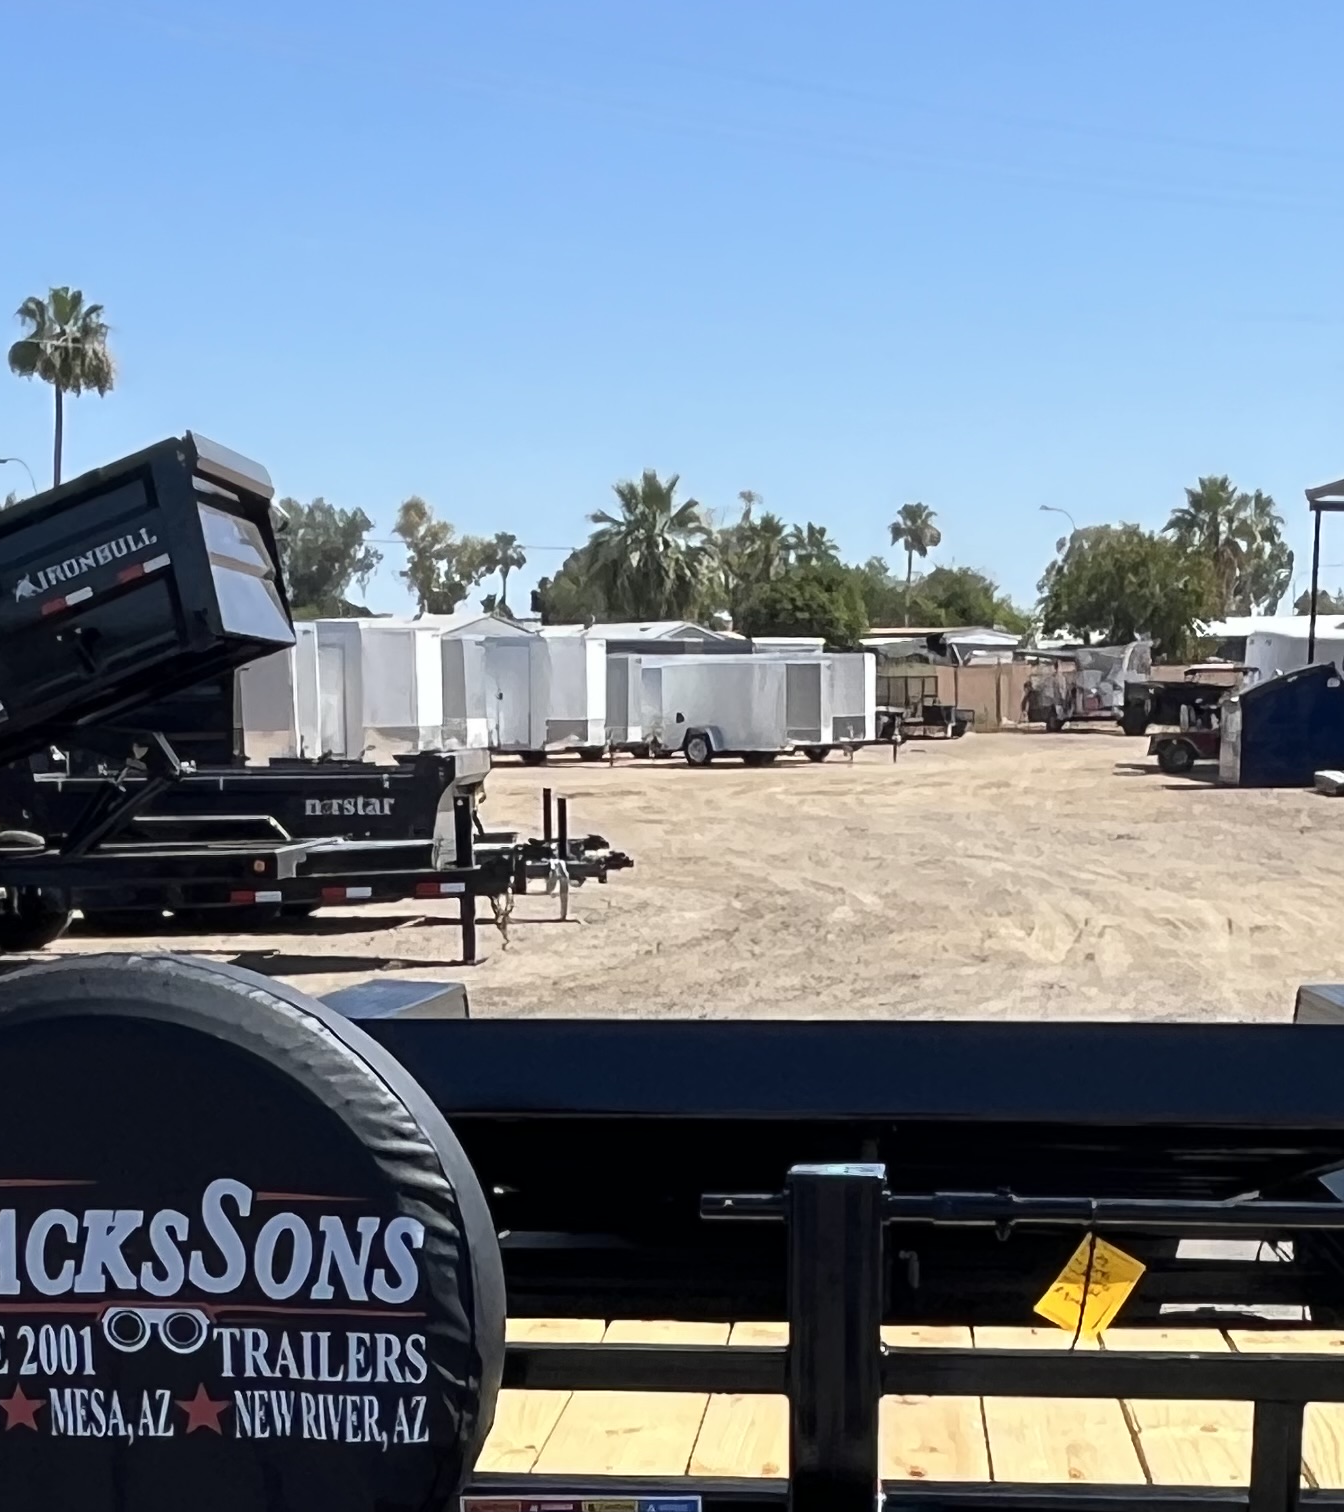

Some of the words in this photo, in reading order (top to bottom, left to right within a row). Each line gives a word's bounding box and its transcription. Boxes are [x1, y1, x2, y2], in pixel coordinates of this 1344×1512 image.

[36, 527, 158, 590] IRONBULL
[16, 1324, 96, 1376] 2001
[213, 1327, 428, 1385] TRAILERS
[49, 1387, 134, 1447] MESA,
[138, 1389, 174, 1437] AZ
[233, 1390, 296, 1439] NEW
[301, 1393, 388, 1452] RIVER,
[392, 1395, 430, 1444] AZ
